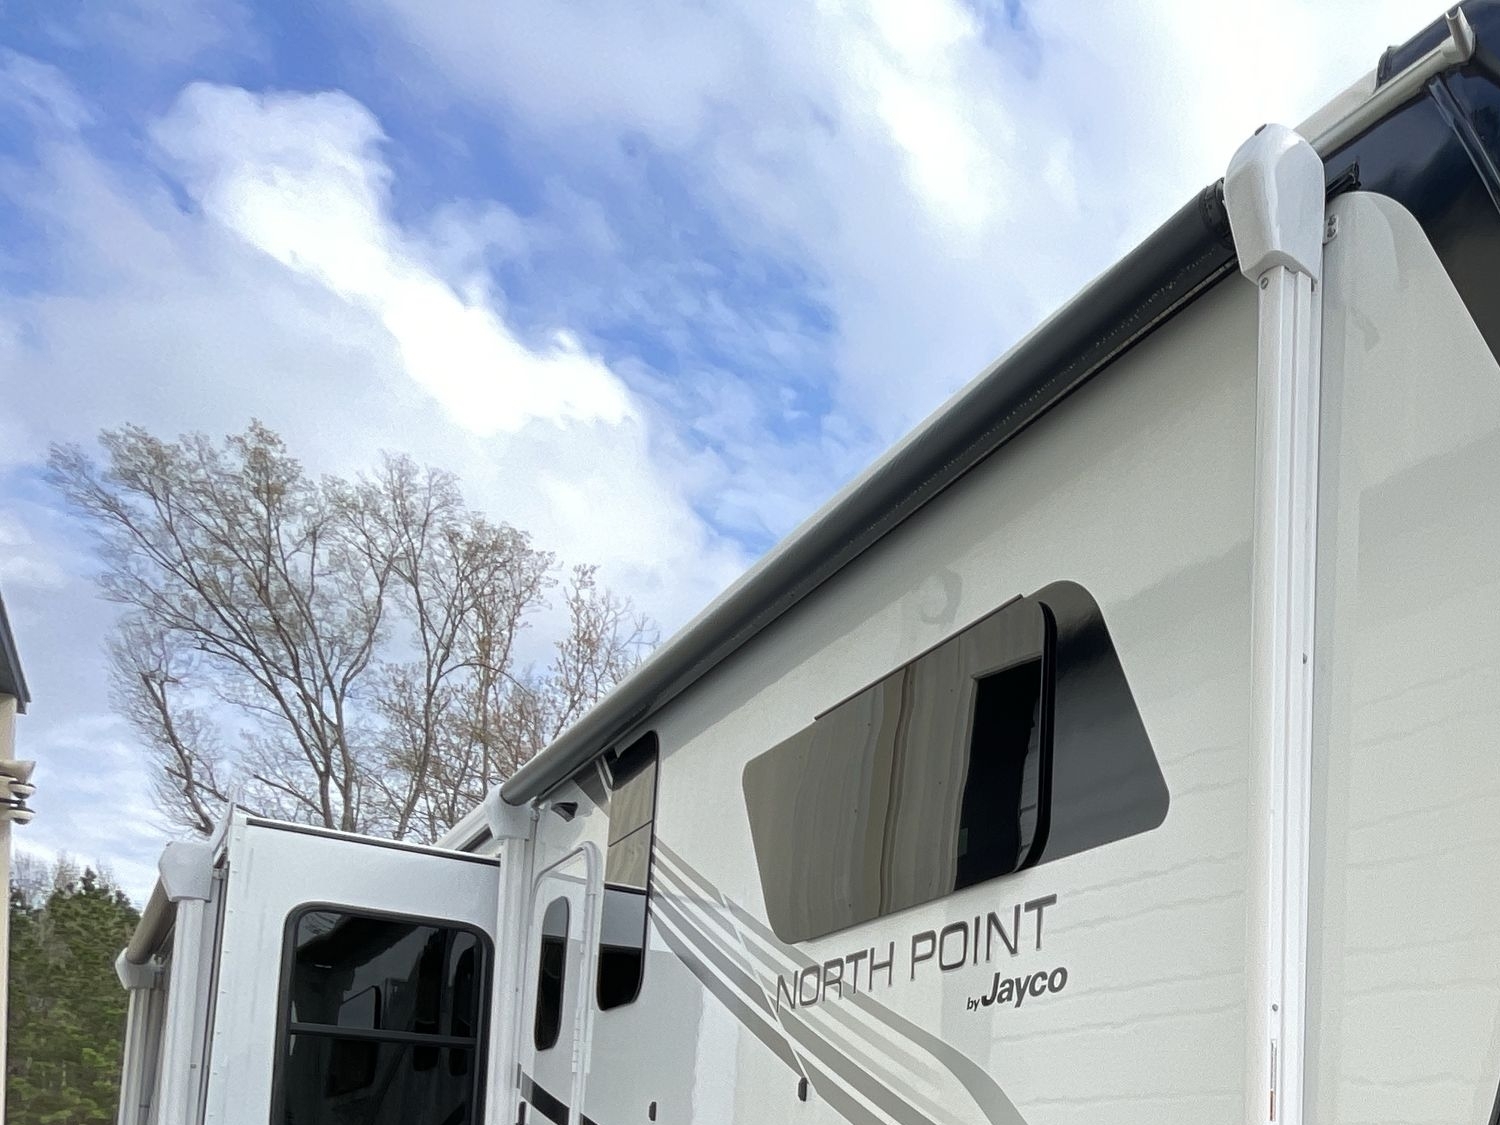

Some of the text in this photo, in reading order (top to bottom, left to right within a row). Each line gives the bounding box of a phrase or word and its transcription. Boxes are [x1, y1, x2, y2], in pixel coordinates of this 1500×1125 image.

[776, 893, 1058, 1014] NORTH POINT
[966, 966, 1068, 1012] by Jayco
